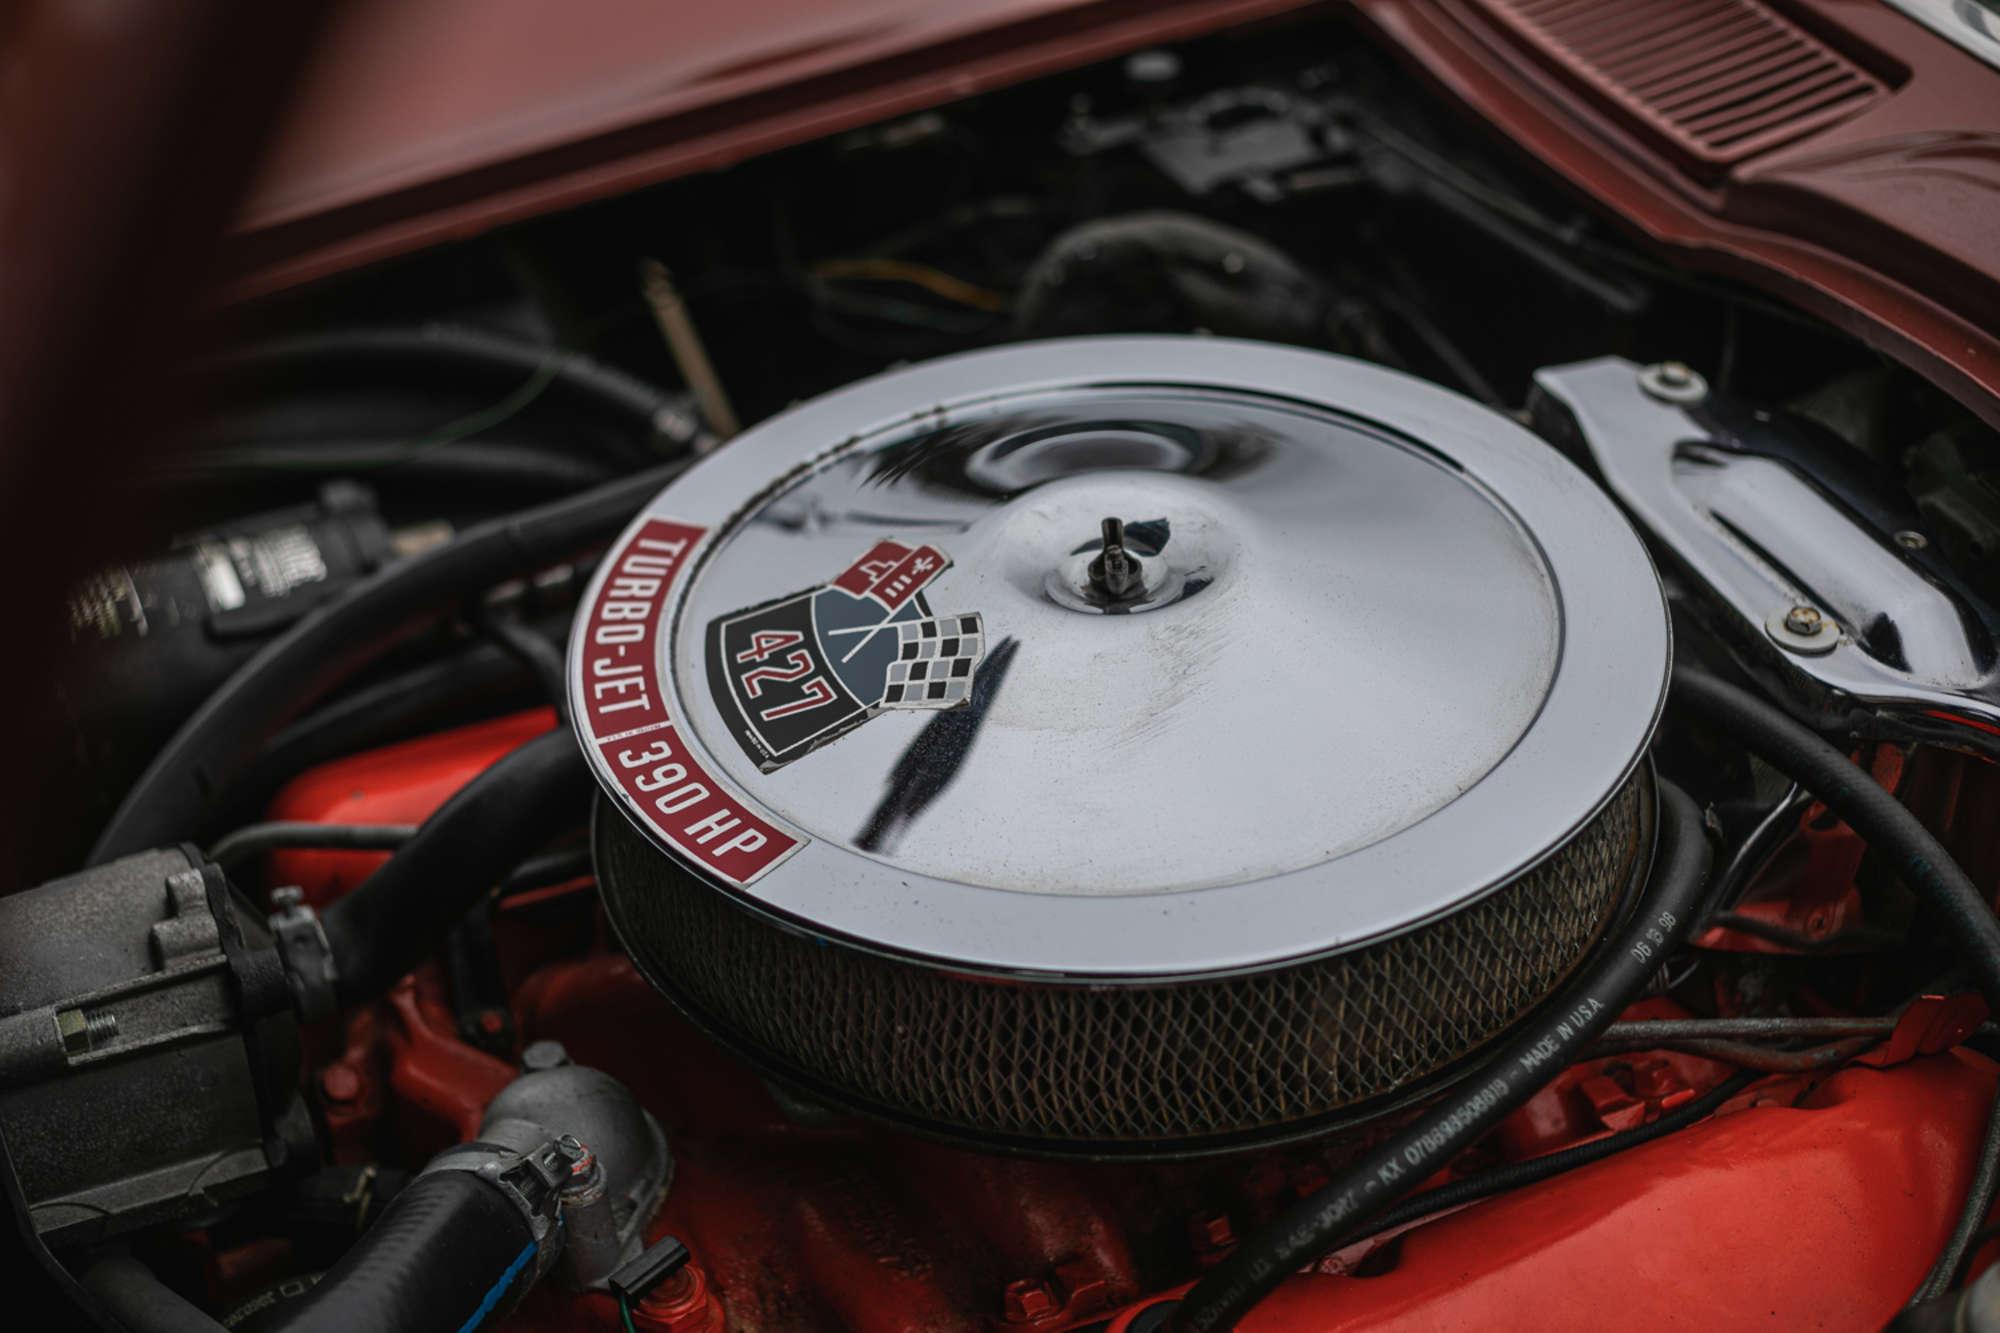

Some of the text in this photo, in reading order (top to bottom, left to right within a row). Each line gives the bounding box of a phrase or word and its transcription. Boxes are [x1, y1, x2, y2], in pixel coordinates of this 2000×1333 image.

[593, 538, 688, 714] TURBO-JET
[736, 629, 839, 722] 427
[618, 740, 711, 815] 390
[684, 808, 768, 857] HP
[1631, 941, 1652, 964] 06
[1658, 911, 1677, 932] 98
[1519, 1034, 1561, 1073] MADE
[1555, 1022, 1575, 1041] IN
